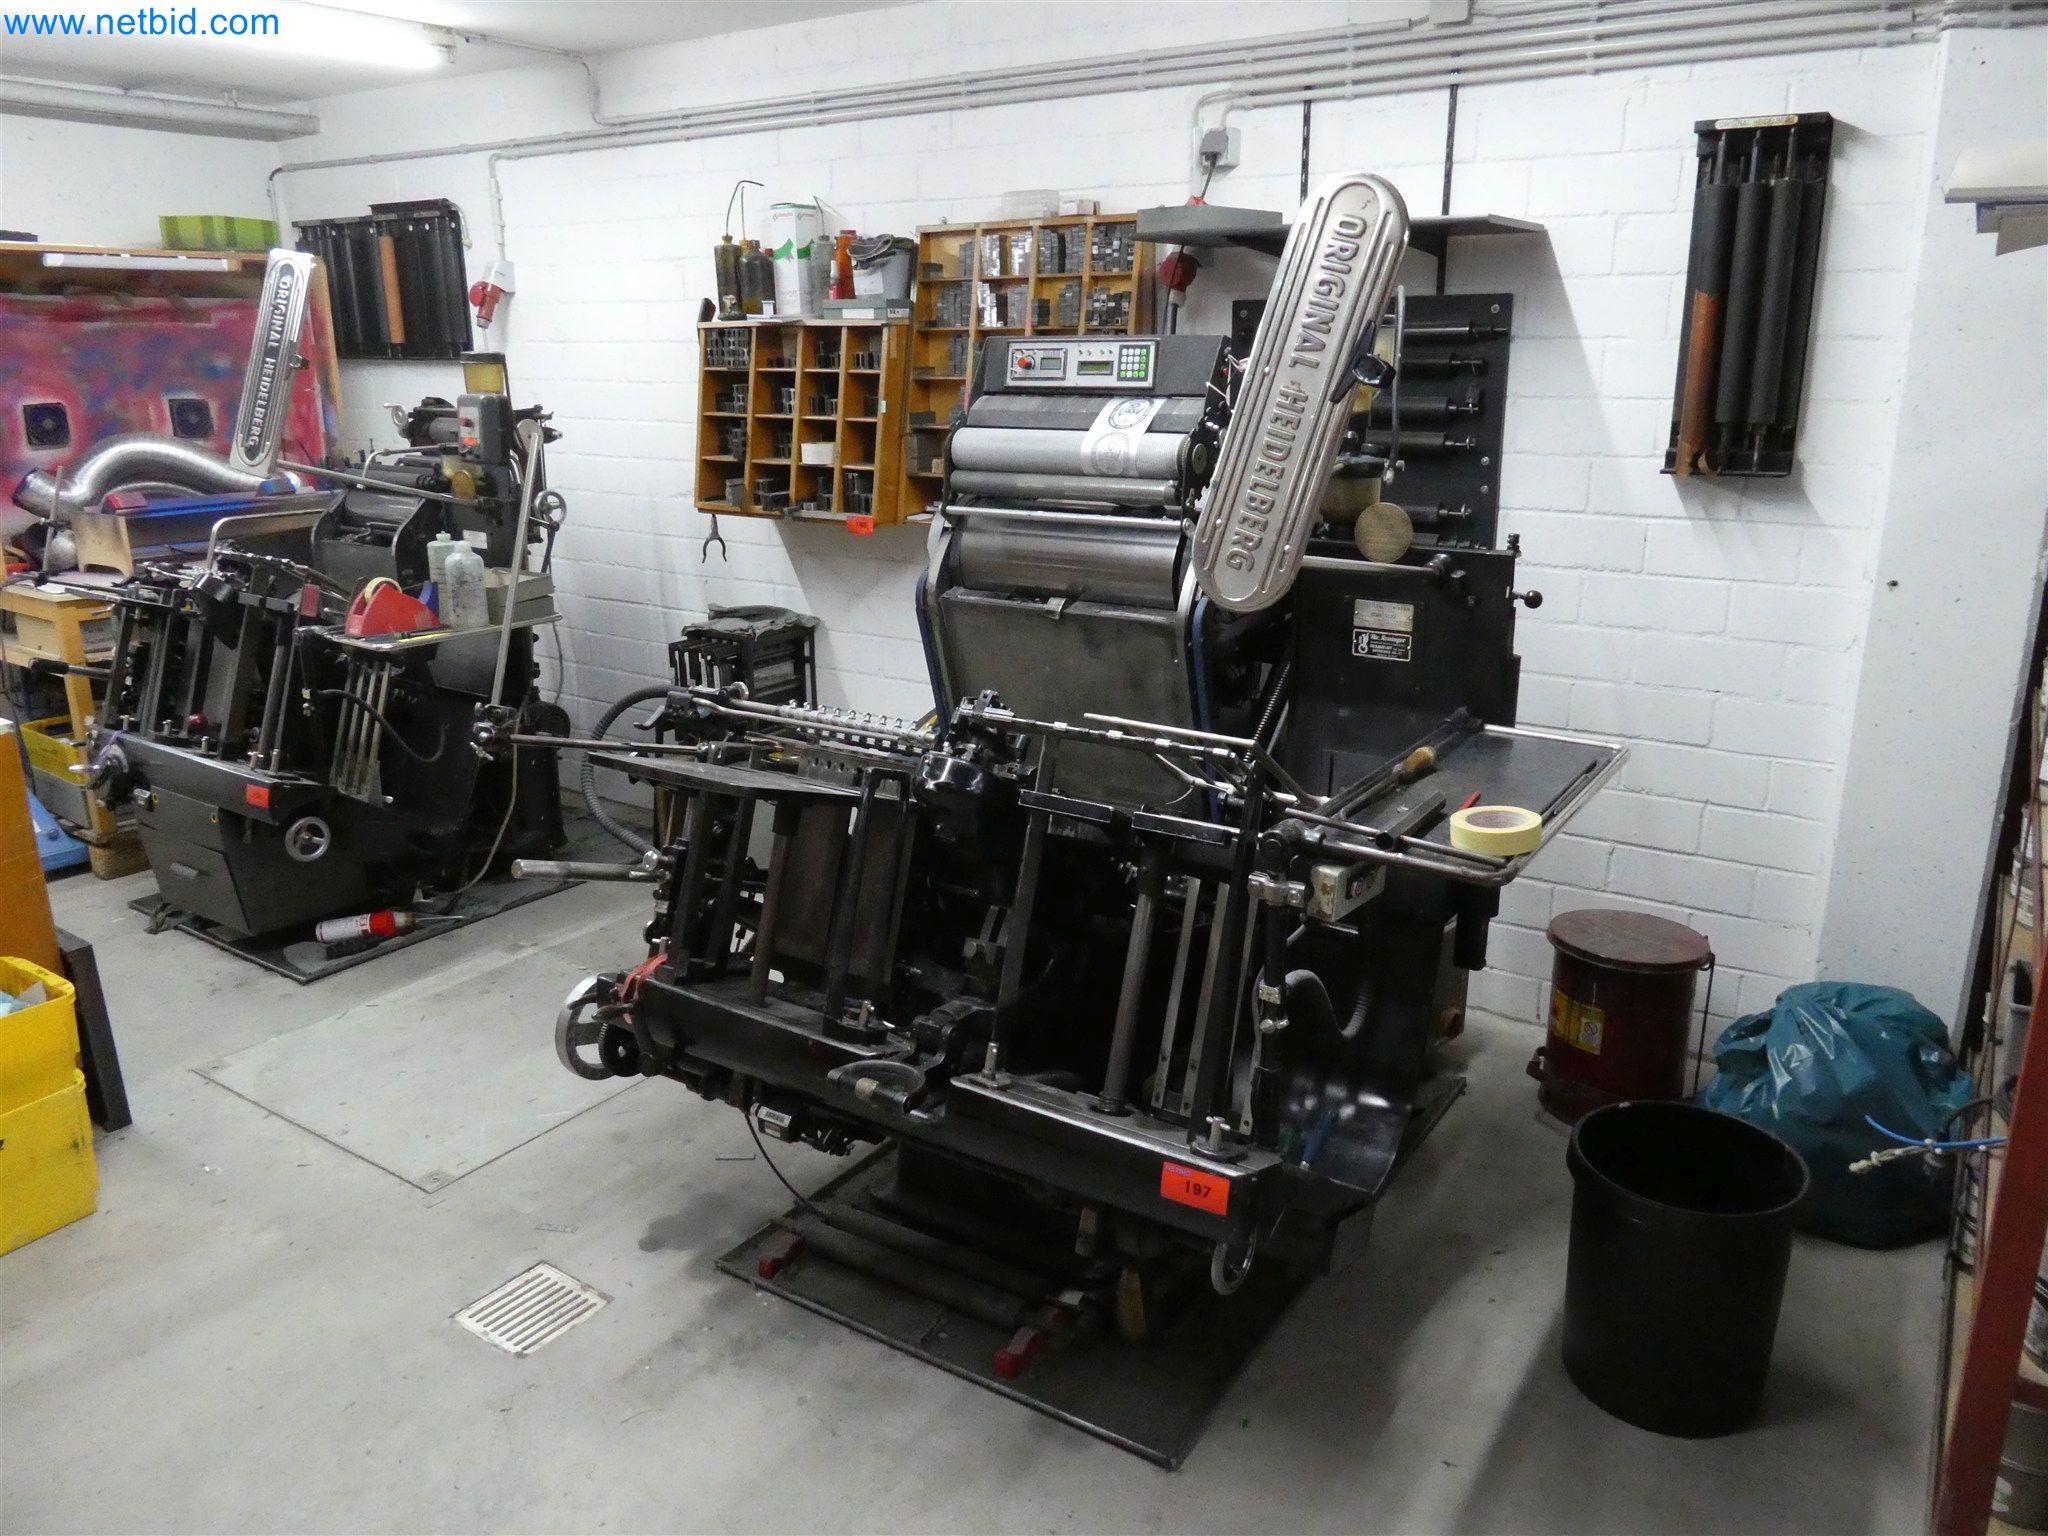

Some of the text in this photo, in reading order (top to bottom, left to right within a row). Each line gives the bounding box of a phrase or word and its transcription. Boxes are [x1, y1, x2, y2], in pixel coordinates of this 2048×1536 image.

[249, 273, 292, 447] ORIGINAL HEIDELBERG
[1226, 213, 1367, 573] ORIGINAL HEIDELBERG
[1185, 1180, 1212, 1199] 197
